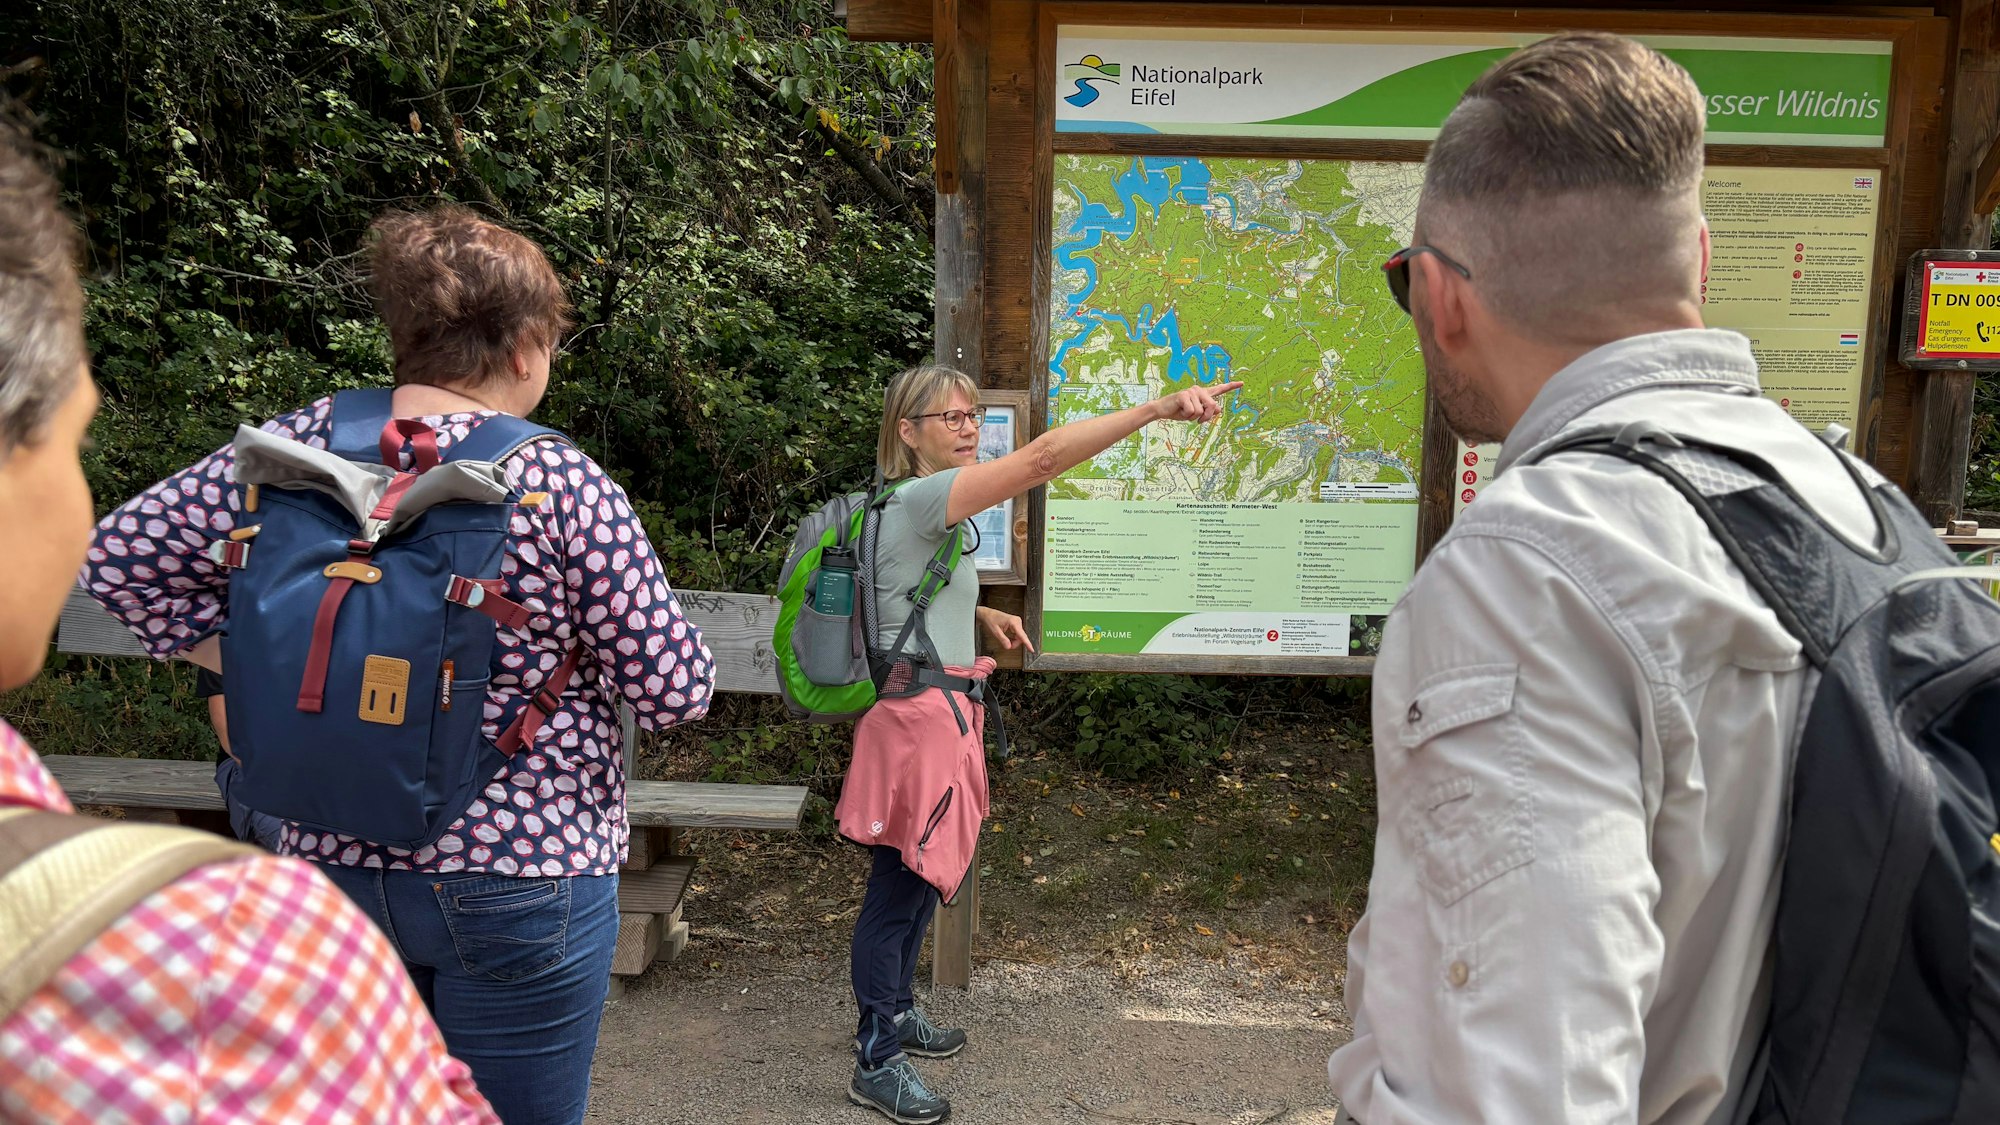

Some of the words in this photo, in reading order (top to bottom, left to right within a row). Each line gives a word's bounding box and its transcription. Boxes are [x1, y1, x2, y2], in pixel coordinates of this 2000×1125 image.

[1132, 65, 1264, 89] Nationalpark
[1131, 88, 1175, 105] Eifel
[1704, 94, 1769, 116] sser
[1776, 89, 1881, 119] Wildnis
[1707, 180, 1741, 188] Welcome
[1931, 294, 1941, 305] T
[1946, 294, 1970, 306] DN
[1046, 630, 1083, 638] WILDNIS
[1270, 632, 1276, 640] Z
